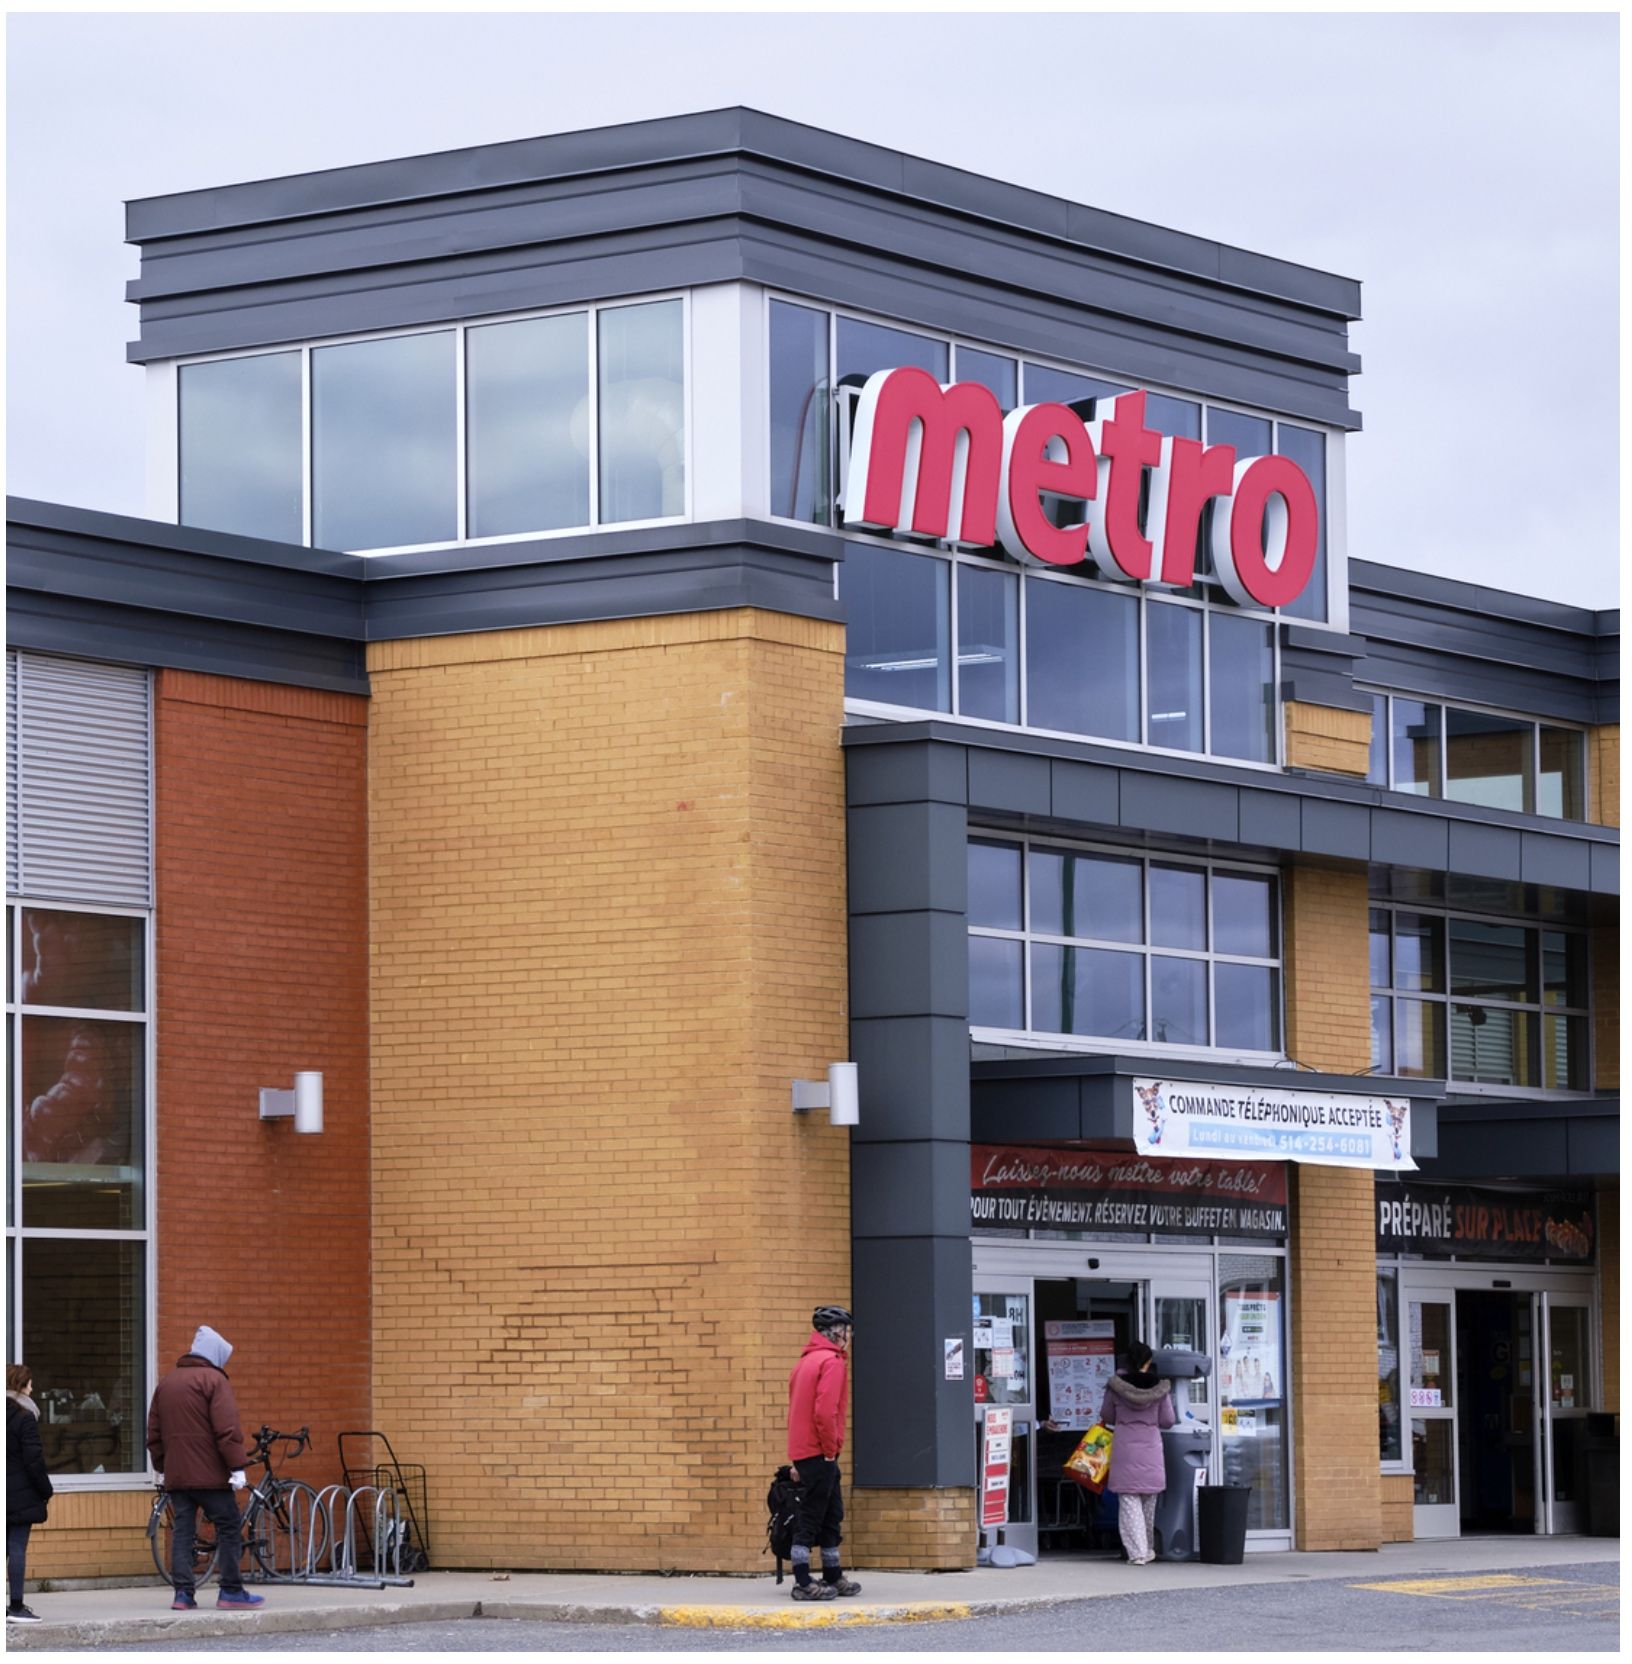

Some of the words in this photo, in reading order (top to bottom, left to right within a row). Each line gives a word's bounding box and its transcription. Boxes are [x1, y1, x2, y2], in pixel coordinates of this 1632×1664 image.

[844, 366, 1318, 607] metro
[1169, 1095, 1235, 1118] COMMANDE
[1237, 1097, 1325, 1128] TÉLÉPHONIQUE
[1328, 1105, 1382, 1128] ACCEPTÉE
[1193, 1128, 1222, 1144] Lundi
[1279, 1133, 1370, 1154] 514-254-6081
[982, 1155, 1103, 1186] Laissez-nous
[1108, 1161, 1165, 1183] mettre
[1168, 1165, 1213, 1188] votre
[1218, 1168, 1267, 1193] table!
[998, 1198, 1025, 1220] TOUT
[1094, 1199, 1148, 1226] RÉSERVEZ
[1150, 1205, 1183, 1226] VOTRE
[1185, 1207, 1220, 1228] BUFFET
[1380, 1193, 1452, 1238] PRÉPARÉ
[1455, 1205, 1489, 1239] SUR
[1492, 1207, 1544, 1242] PLACE
